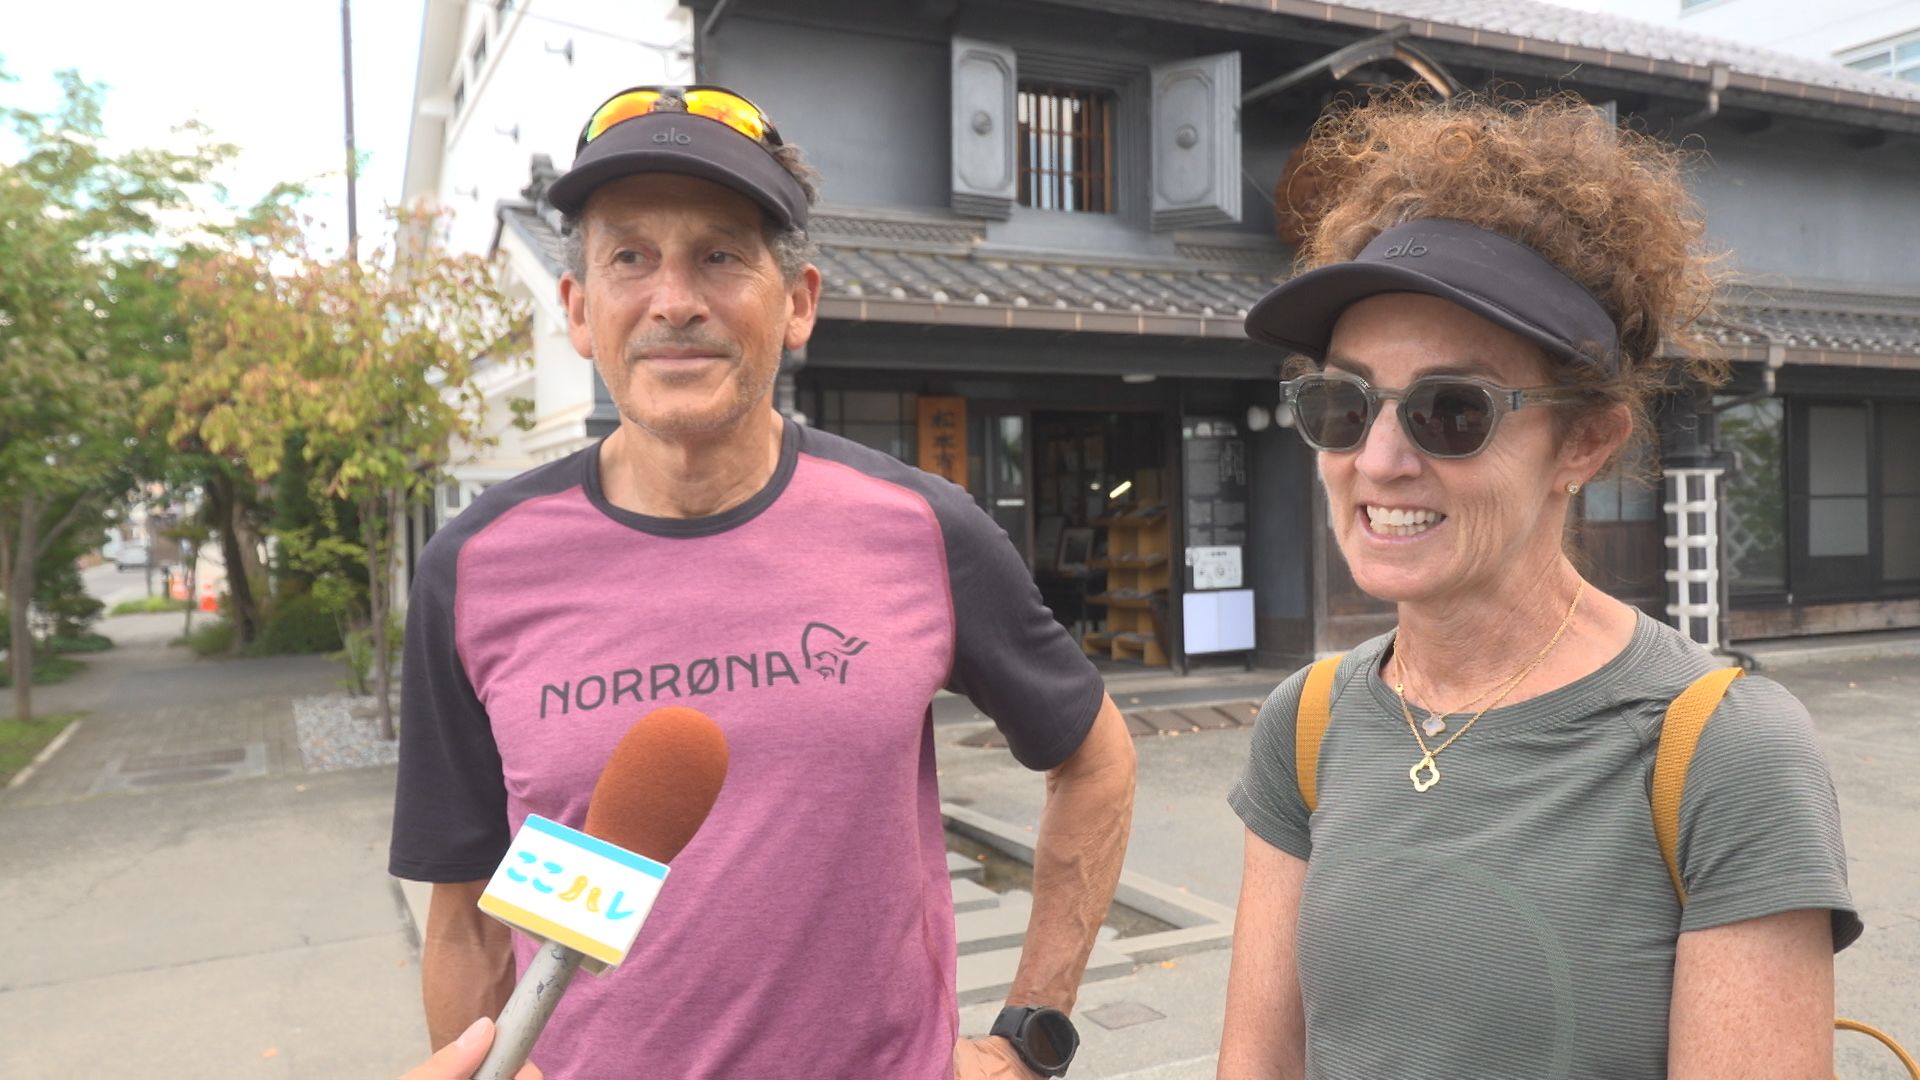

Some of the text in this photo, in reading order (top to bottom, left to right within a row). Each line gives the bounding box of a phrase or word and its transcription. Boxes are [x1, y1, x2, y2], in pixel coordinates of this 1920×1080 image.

[652, 127, 692, 145] alo
[1384, 236, 1428, 258] alo
[539, 650, 800, 719] NORRØNA
[506, 850, 636, 921] ここハレ
